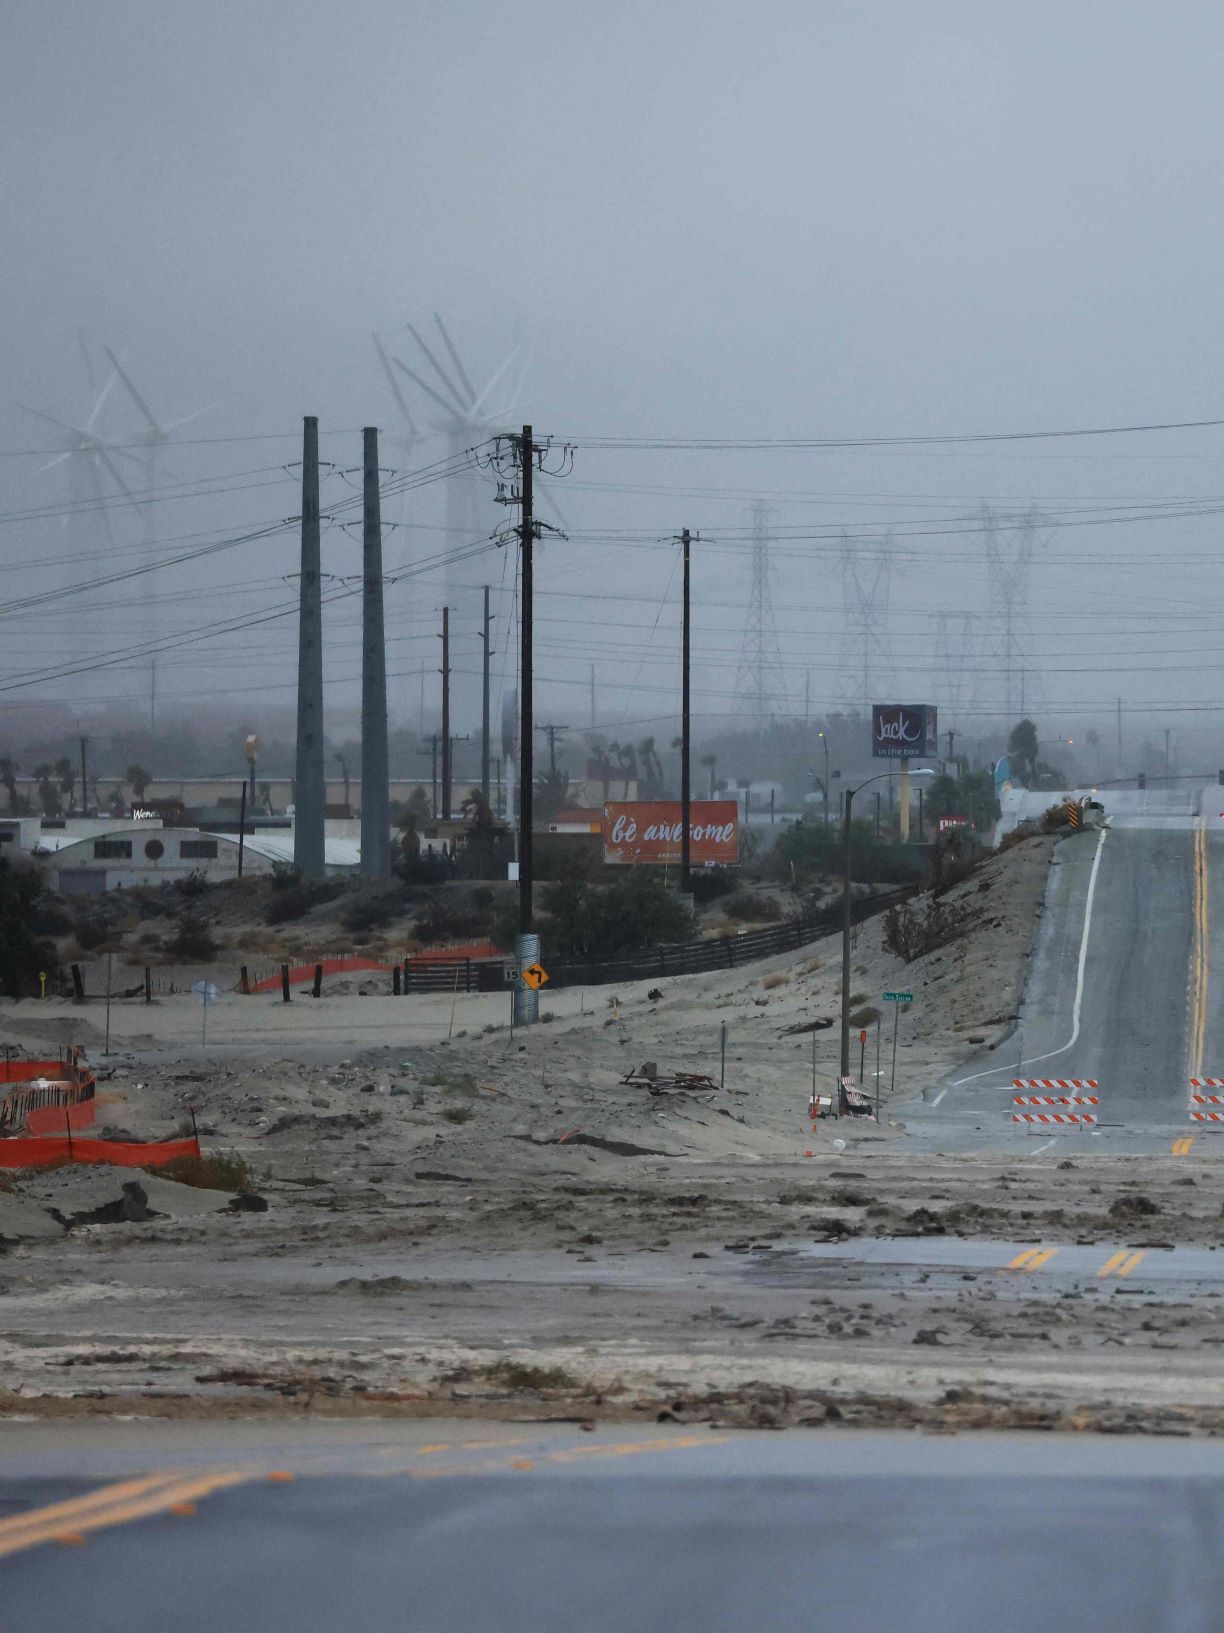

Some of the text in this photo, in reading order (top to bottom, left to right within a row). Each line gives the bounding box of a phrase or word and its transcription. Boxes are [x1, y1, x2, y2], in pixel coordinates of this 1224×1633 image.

[876, 711, 921, 742] Jack
[889, 747, 902, 755] the
[611, 815, 734, 843] be aweome
[507, 970, 519, 980] 15
